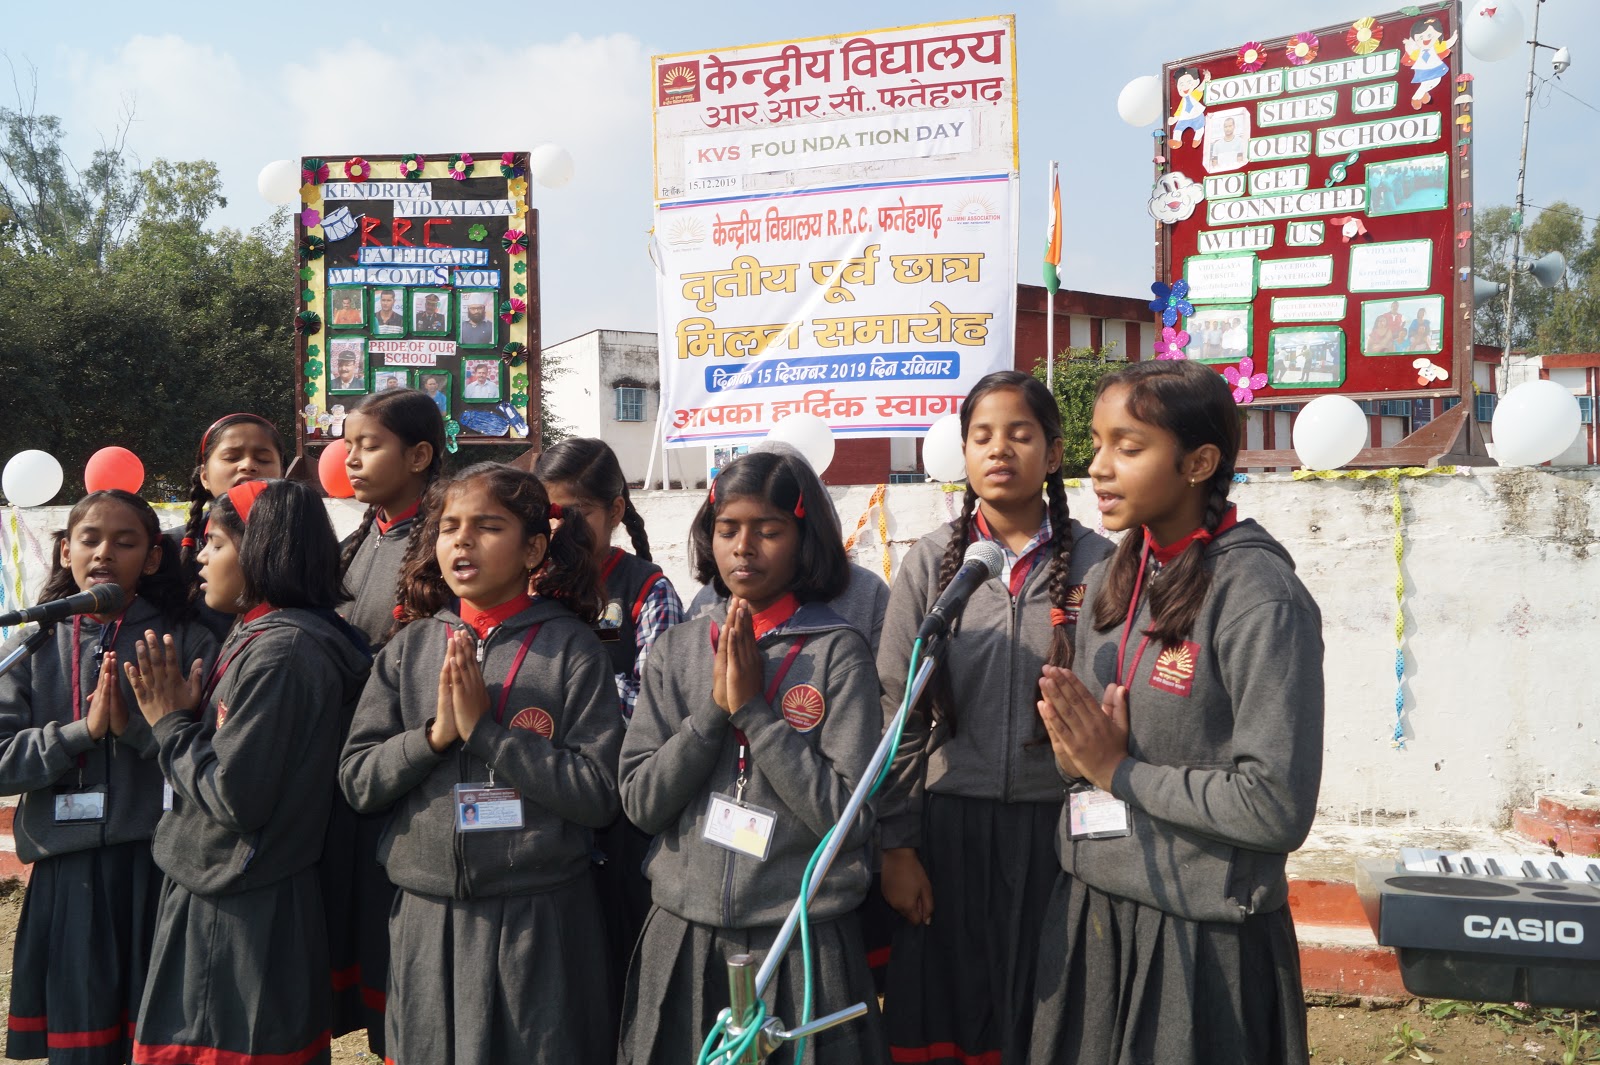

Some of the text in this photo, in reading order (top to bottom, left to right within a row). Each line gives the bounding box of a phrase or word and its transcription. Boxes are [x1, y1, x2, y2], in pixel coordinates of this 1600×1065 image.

[703, 29, 1006, 97] केन्द्रीय विद्यालय
[1209, 52, 1397, 102] SOME USEFUL
[876, 76, 1005, 108] फतेहगढ़
[1263, 85, 1393, 123] SITES OF
[697, 145, 741, 165] KVS
[916, 121, 965, 142] DAY
[1253, 118, 1438, 157] OUR SCHOOL
[324, 183, 431, 199] KENDRIYA
[688, 178, 736, 191] 15.12.2019
[1209, 167, 1306, 196] TO GET
[396, 200, 513, 216] VIDYALAYA
[1211, 187, 1366, 221] CONNECTED
[712, 196, 943, 250] केन्द्रीय विद्यालय R.R.C. फतेहगढ़
[1204, 224, 1323, 250] WITH US
[360, 248, 486, 264] FATEHGARH
[331, 266, 499, 286] WELCOMES YOU
[680, 244, 986, 313] तृतीय पूर्व छात्र
[1277, 271, 1327, 281] FATEHGARH
[676, 300, 994, 359] मिलन समारोह
[369, 341, 455, 354] PRIDE OF OUR
[385, 353, 436, 364] SCHOOL
[712, 356, 953, 390] दिनांक 15 दिसम्बर 2019 दिन रविवार
[673, 389, 966, 429] आपका हार्दिक स्वाग
[1463, 914, 1585, 945] CASIO
